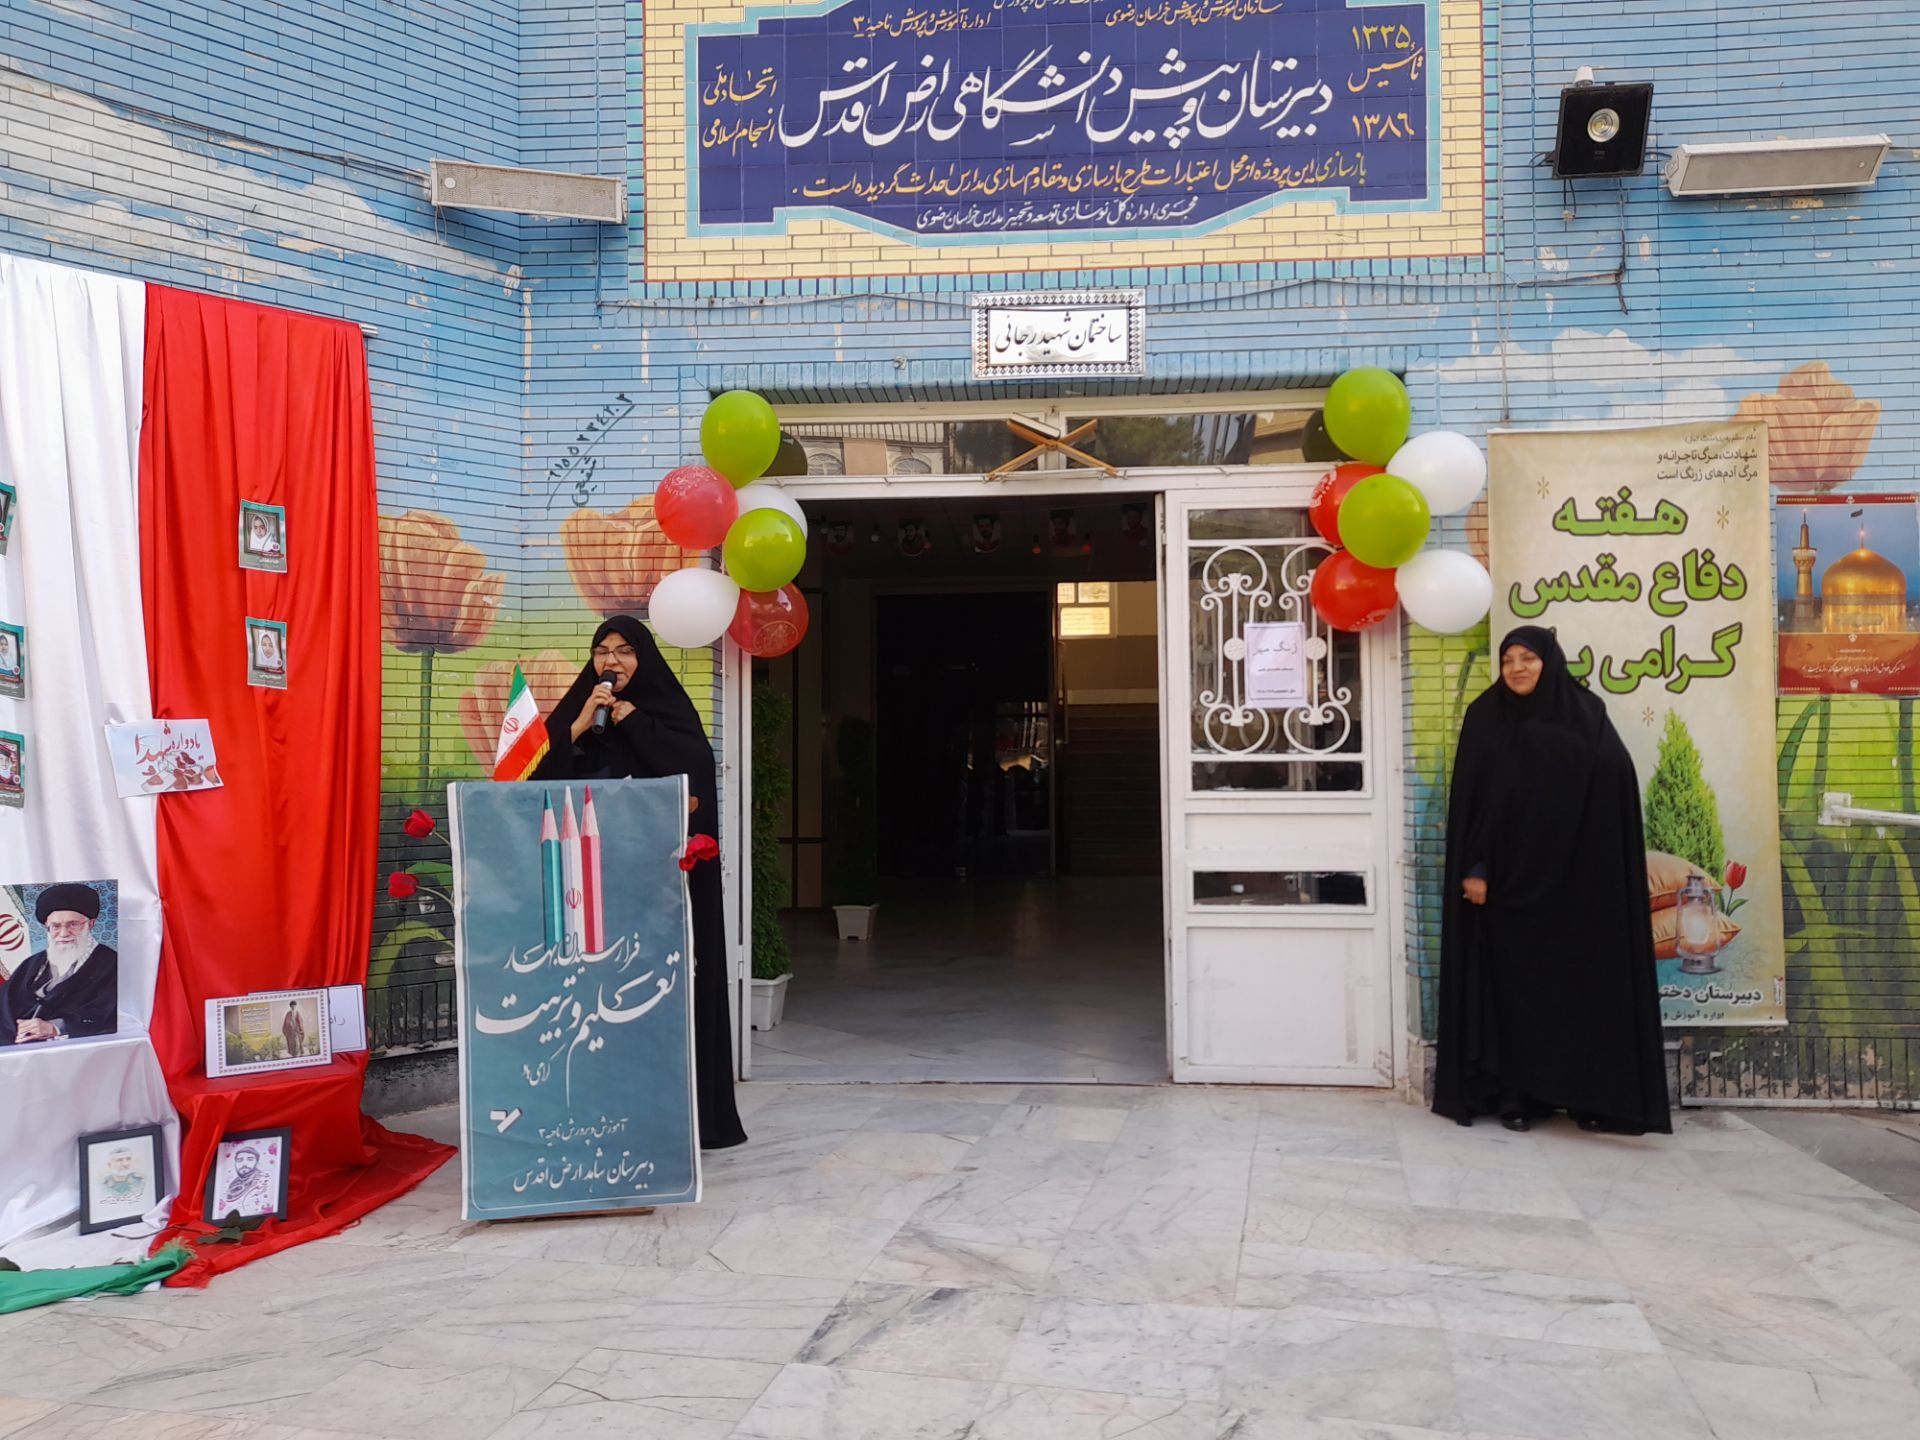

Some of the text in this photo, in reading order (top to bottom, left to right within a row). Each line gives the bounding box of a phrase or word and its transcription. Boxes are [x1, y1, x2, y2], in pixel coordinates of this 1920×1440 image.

[1105, 3, 1136, 27] رضوی
[1135, 1, 1171, 27] خراسان
[1351, 23, 1412, 50] ۱۳۳۵
[779, 57, 898, 147] اقدس
[863, 54, 950, 146] ارض
[1086, 48, 1241, 149] پیش
[1196, 48, 1333, 139] دبیرستان
[1066, 160, 1122, 192] بازسازی
[1141, 157, 1219, 191] اعتبارات
[1214, 154, 1249, 190] محل
[1254, 157, 1291, 188] پروژه
[1287, 158, 1315, 188] این
[1315, 151, 1367, 184] بازسازی
[1036, 311, 1072, 355] شهید
[1067, 313, 1122, 351] ساختمان
[1663, 449, 1698, 464] تاجرانه
[1697, 446, 1719, 464] مرگ
[1657, 469, 1678, 480] است
[1680, 466, 1703, 482] زرنگ
[1738, 464, 1758, 482] مرگ
[1551, 485, 1689, 536] هفته
[1508, 548, 1748, 618] دفاع مقدس
[1599, 622, 1742, 694] گرامی
[502, 942, 558, 974] بهار
[475, 974, 577, 1043] تربیت
[1694, 985, 1762, 1005] دبیرستان
[566, 950, 681, 1108] تعلیم
[561, 1117, 591, 1146] پرورش
[594, 1115, 629, 1138] آموزش
[513, 1156, 550, 1192] اقدس
[550, 1155, 583, 1189] ارض
[606, 1150, 655, 1190] دبیرستان
